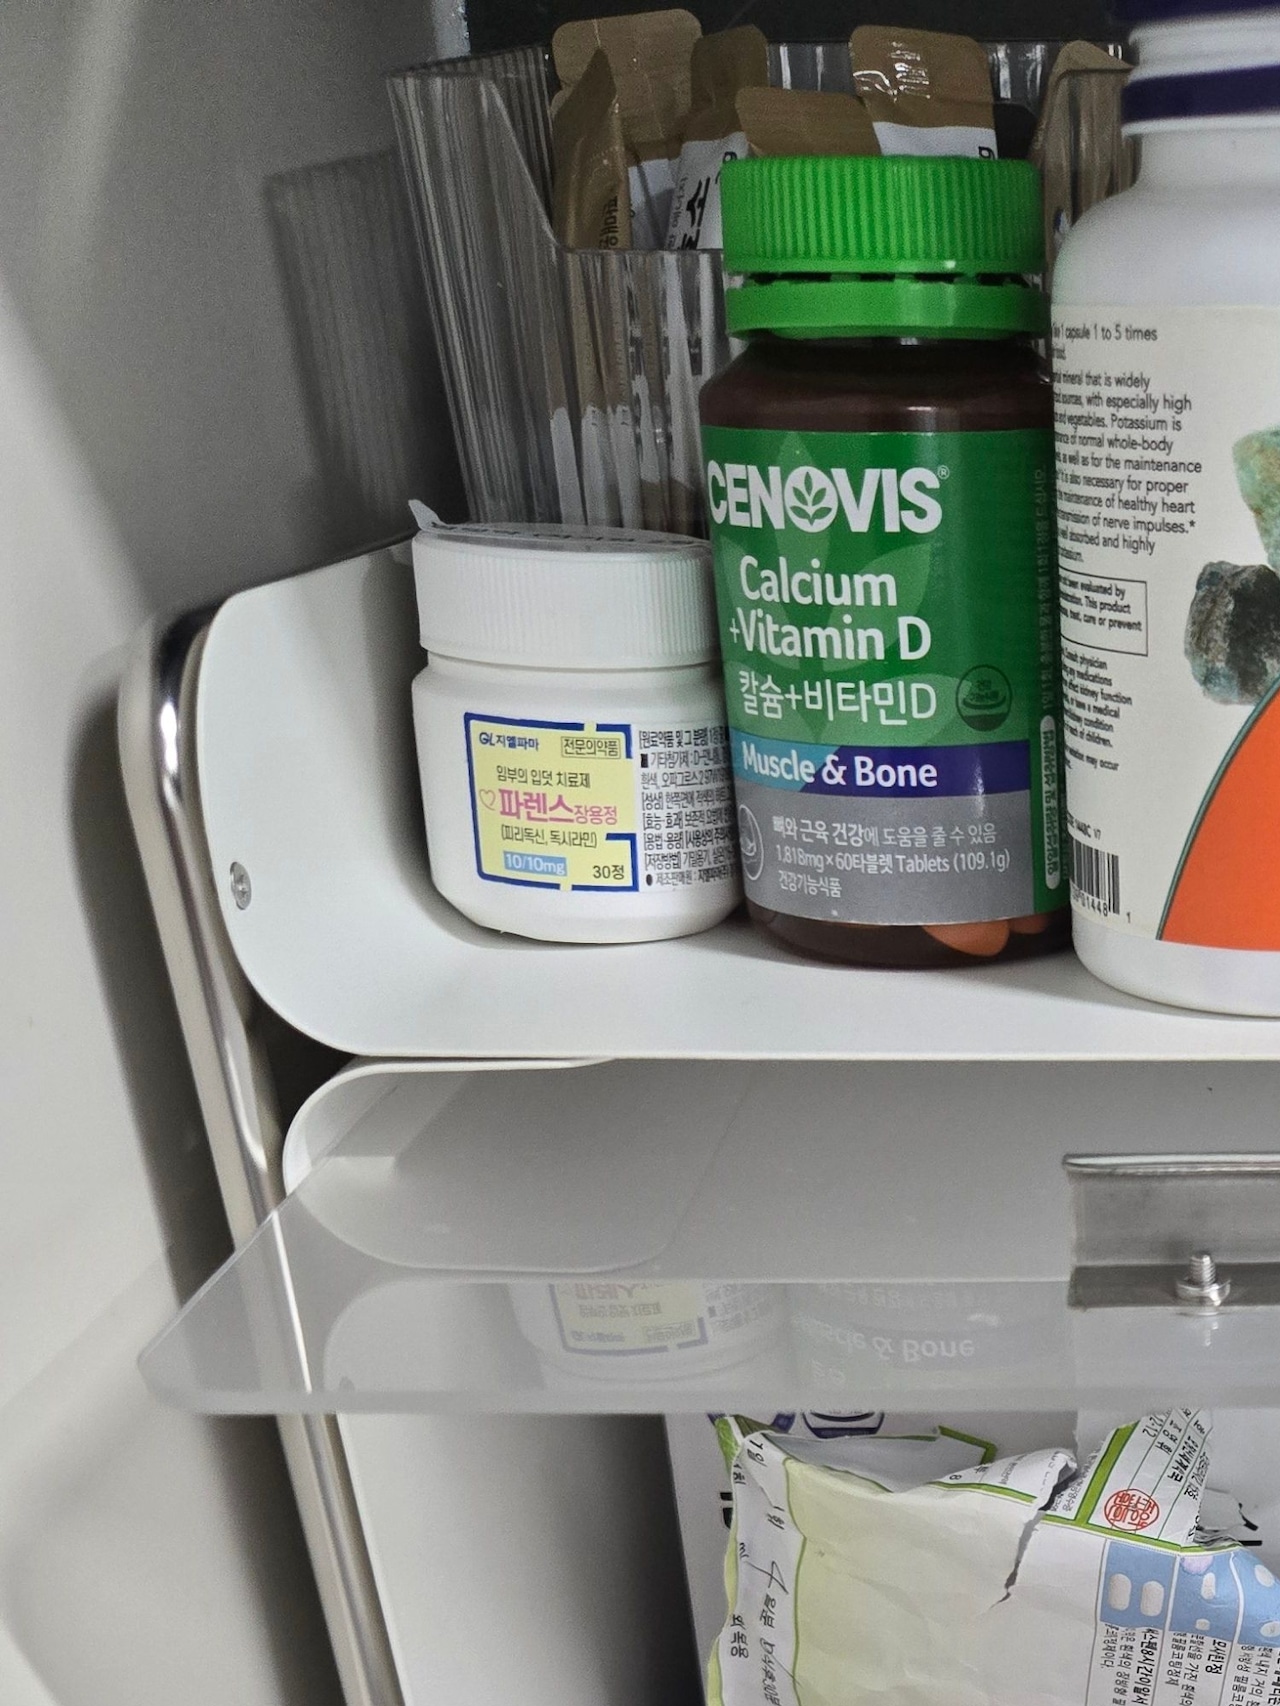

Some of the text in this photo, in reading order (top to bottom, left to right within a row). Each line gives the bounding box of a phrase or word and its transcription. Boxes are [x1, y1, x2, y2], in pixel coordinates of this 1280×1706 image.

[1101, 326, 1158, 341] to times
[1114, 372, 1150, 392] widely
[1106, 394, 1192, 414] especially high
[1110, 412, 1182, 432] Potassium is
[1107, 434, 1173, 454] whole-body
[1105, 452, 1202, 473] the maintenance
[1083, 475, 1189, 496] necessary for proper
[1118, 495, 1195, 515] healthy heart
[1103, 515, 1130, 530] nerve
[1102, 531, 1155, 555] and highly
[740, 555, 897, 606] Calcium
[1115, 583, 1126, 600] by
[1099, 600, 1131, 615] product
[730, 607, 932, 660] +Vitamin D
[1109, 618, 1142, 631] prevent
[739, 670, 937, 726] 칼슘+비타민D
[1100, 690, 1132, 706] function
[563, 738, 618, 756] 전문의약품
[742, 741, 938, 788] Muscle & Bone
[496, 765, 590, 788] 임부의 입덧 치료제
[772, 815, 998, 847] 뼈와 근육 건강에 도움을 줄 수 있음
[505, 853, 566, 876] 10/10mg
[896, 849, 1010, 874] Tablets (109.1g)
[593, 864, 624, 880] 30정
[778, 870, 842, 898] 건강기능식품
[1183, 1662, 1199, 1681] 가진
